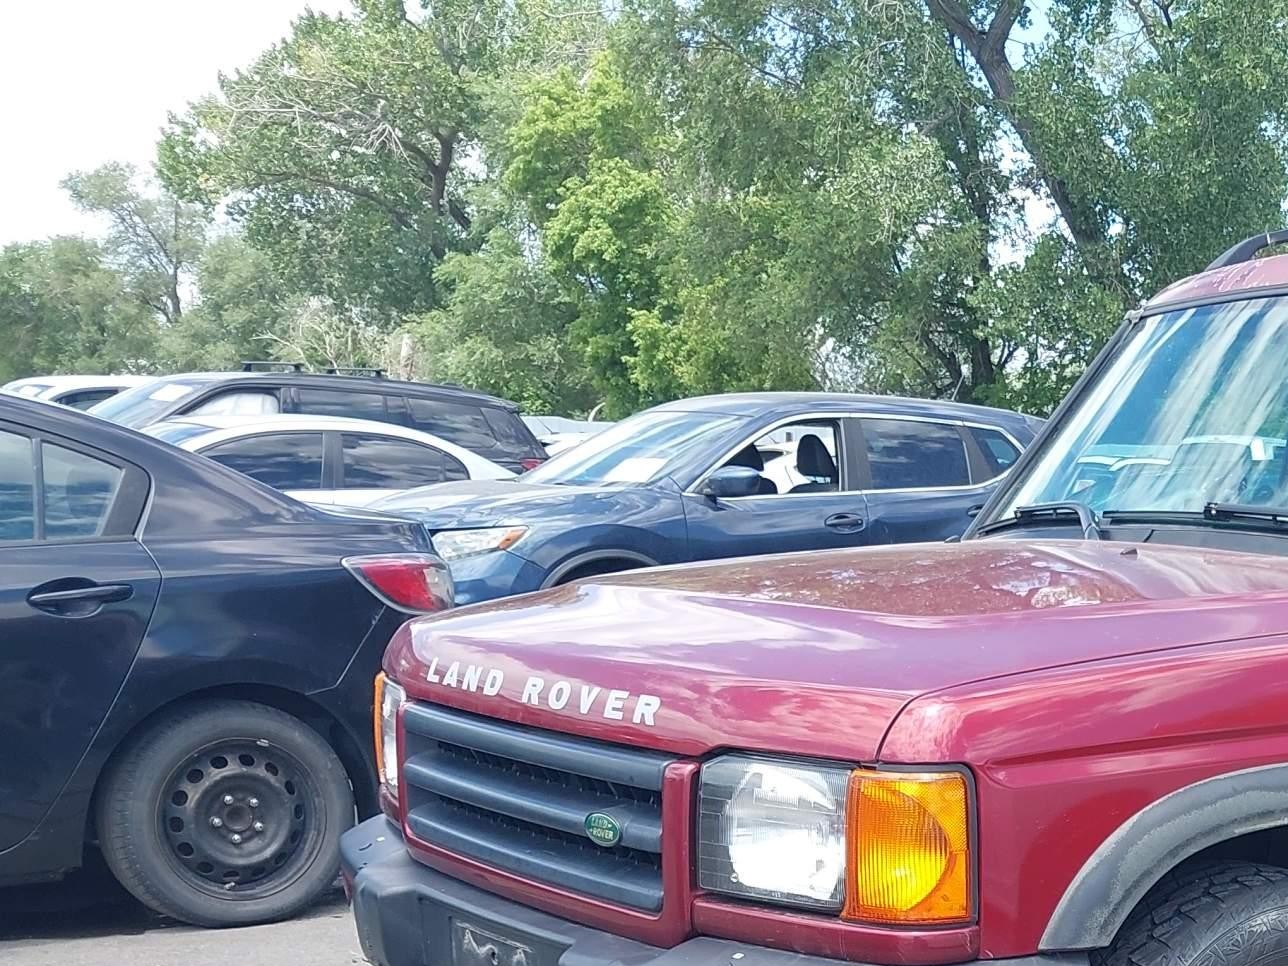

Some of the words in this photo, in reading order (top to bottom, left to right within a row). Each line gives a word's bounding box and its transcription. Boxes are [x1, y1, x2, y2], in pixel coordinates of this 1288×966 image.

[426, 657, 505, 697] LAND
[521, 676, 661, 726] ROVER
[592, 827, 614, 841] ROVER
